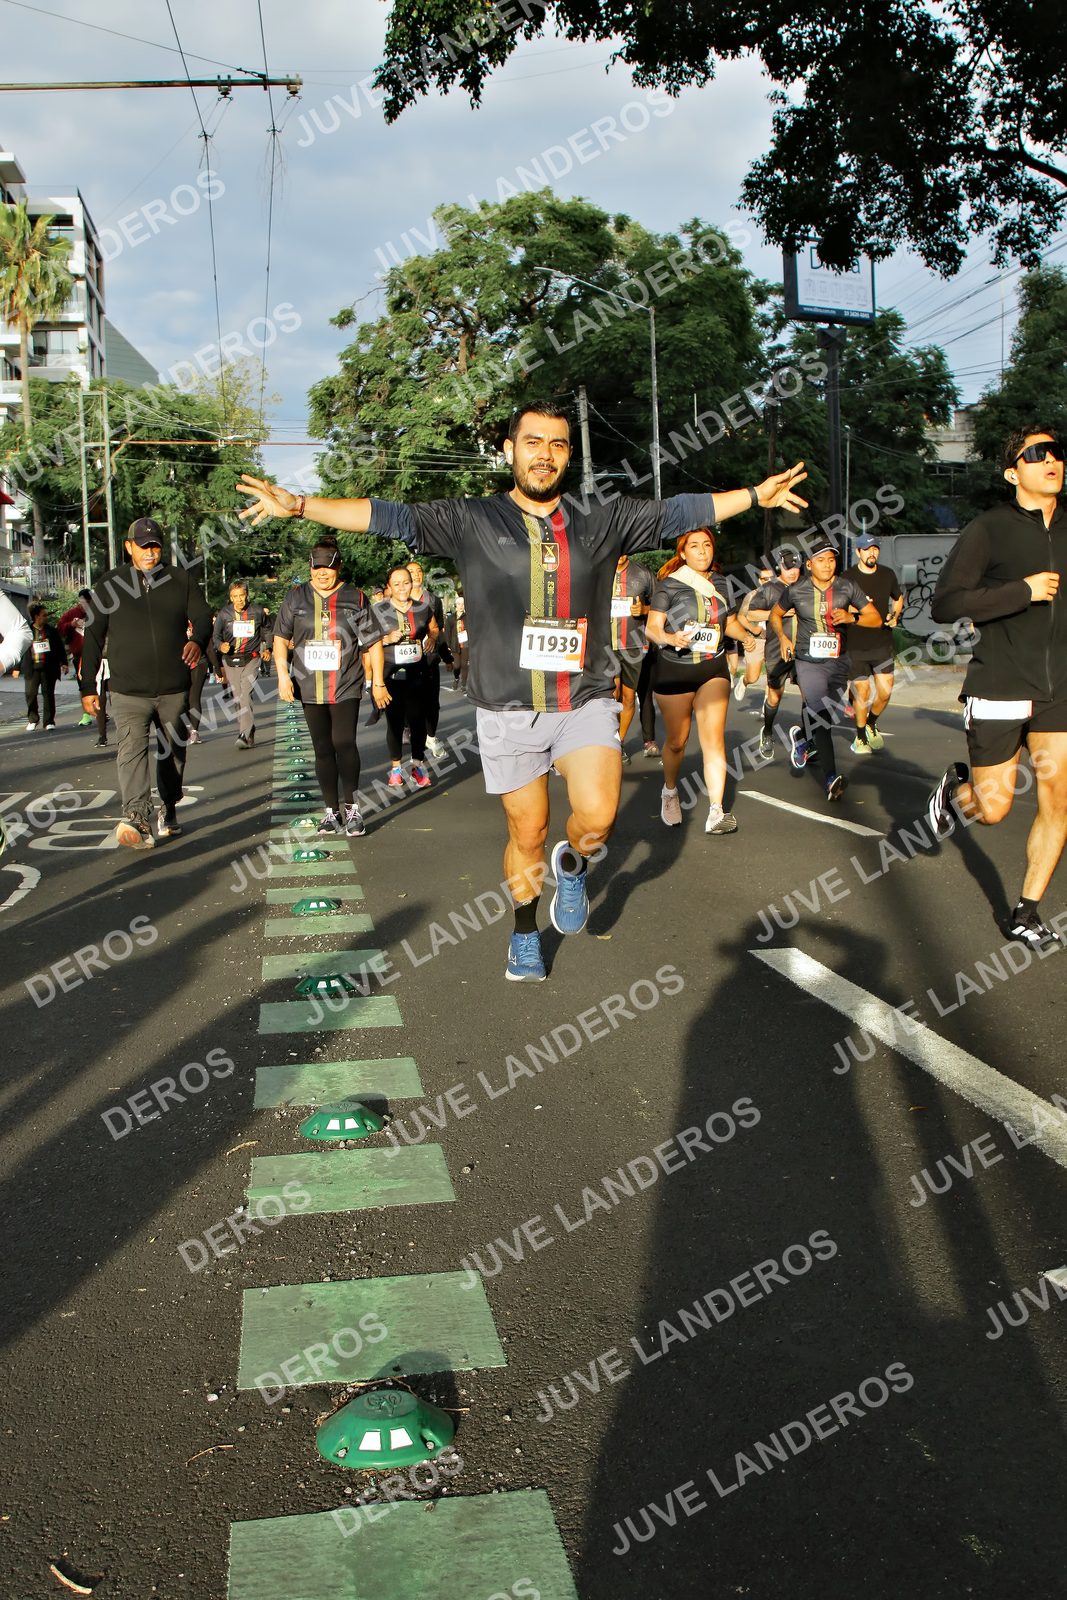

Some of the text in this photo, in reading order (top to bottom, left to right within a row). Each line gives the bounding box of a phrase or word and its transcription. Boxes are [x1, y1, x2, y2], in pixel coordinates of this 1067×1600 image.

[691, 631, 713, 642] 080
[526, 634, 579, 653] 11939
[813, 640, 837, 650] 13005
[308, 650, 336, 660] 10296
[399, 647, 417, 656] 4634
